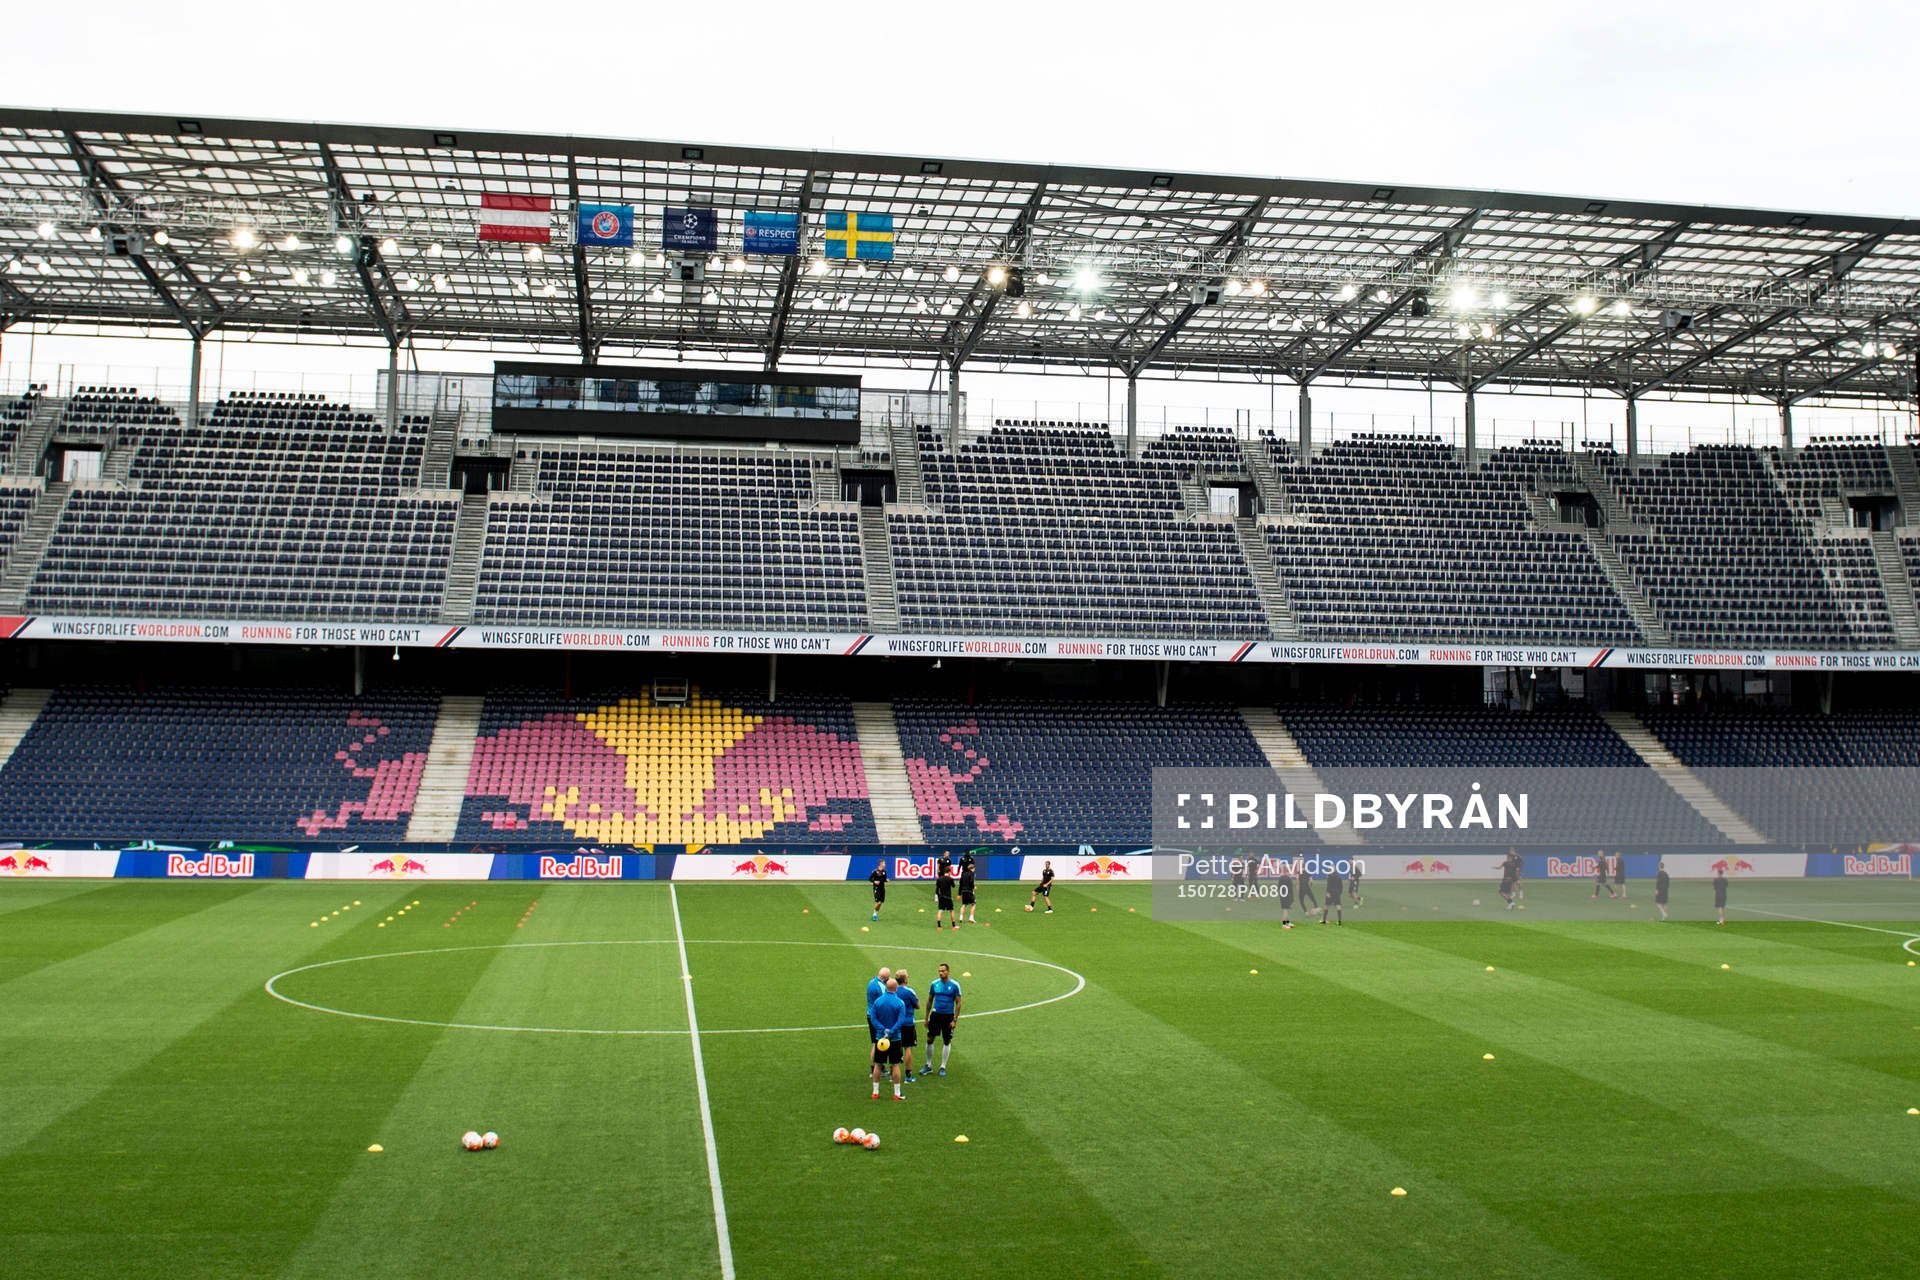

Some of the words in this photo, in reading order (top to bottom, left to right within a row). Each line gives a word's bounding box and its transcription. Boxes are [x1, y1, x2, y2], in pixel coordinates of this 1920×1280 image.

[758, 229, 796, 239] RESPECT
[52, 622, 229, 638] WINGSFORLIFEWORLDRUN.COM
[242, 626, 292, 639] RUNNING
[296, 628, 318, 640] FOR
[321, 628, 356, 641] THOSE
[359, 629, 385, 642] WHO
[389, 630, 420, 642] CAN'T
[481, 632, 650, 647] WINGSFORLIFEWORLDRUN.COM
[662, 635, 710, 647] RUNNING
[714, 636, 734, 648] FOR
[737, 637, 770, 649] THOSE
[774, 637, 797, 649] WHO
[801, 638, 830, 650] CAN'T
[888, 640, 1047, 655] WINGSFORLIFEWORLDRUN.COM
[1058, 643, 1103, 655] RUNNING
[1106, 643, 1126, 656] FOR
[1129, 644, 1160, 656] THOSE
[1163, 644, 1186, 657] WHO
[1189, 645, 1217, 657] CAN'T
[1271, 647, 1420, 661] WINGSFORLIFEWORLDRUN.COM
[1429, 650, 1472, 662] RUNNING
[1475, 651, 1493, 662] FOR
[1496, 651, 1524, 663] THOSE
[1527, 651, 1548, 663] WHO
[1551, 652, 1576, 663] CAN'T
[1627, 653, 1766, 667] WINGSFORLIFEWORLDRUN.COM
[1775, 655, 1817, 667] RUNNING
[1820, 656, 1838, 667] FOR
[1842, 656, 1870, 667] THOSE
[1873, 656, 1896, 667] WHO
[169, 854, 211, 876] Red
[212, 854, 254, 876] Bull
[541, 856, 582, 877] Red
[583, 856, 621, 877] Bull
[896, 858, 934, 879] Red
[1548, 857, 1582, 876] Red
[1845, 855, 1877, 875] Red
[1878, 855, 1910, 875] Bull
